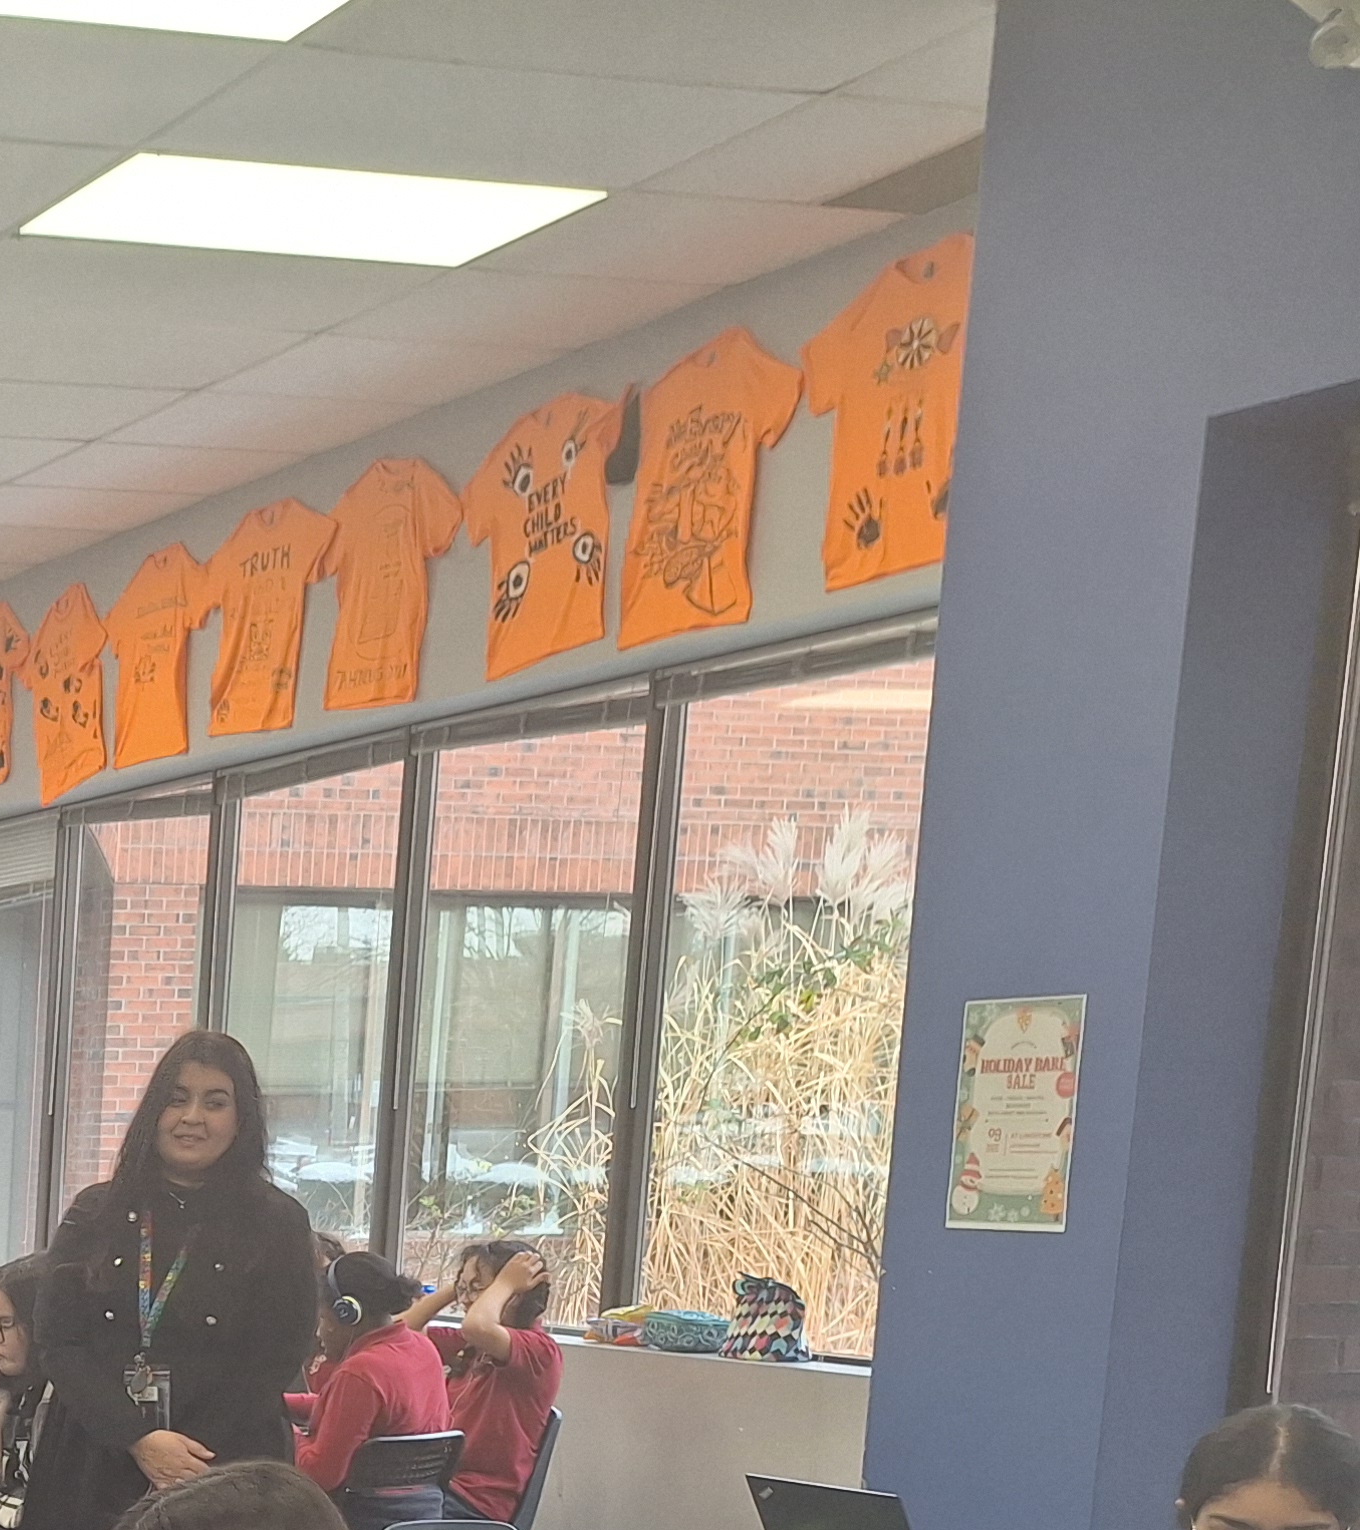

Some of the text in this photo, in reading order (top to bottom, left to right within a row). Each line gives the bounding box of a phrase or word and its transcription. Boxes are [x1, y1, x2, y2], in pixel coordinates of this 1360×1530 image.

[528, 471, 567, 514] EVERY
[524, 502, 561, 538] CHILD
[527, 516, 577, 558] MATTERS
[239, 543, 292, 579] TRUTH
[981, 1056, 1066, 1074] HOLIDAY BAKE
[1006, 1073, 1036, 1090] SALE
